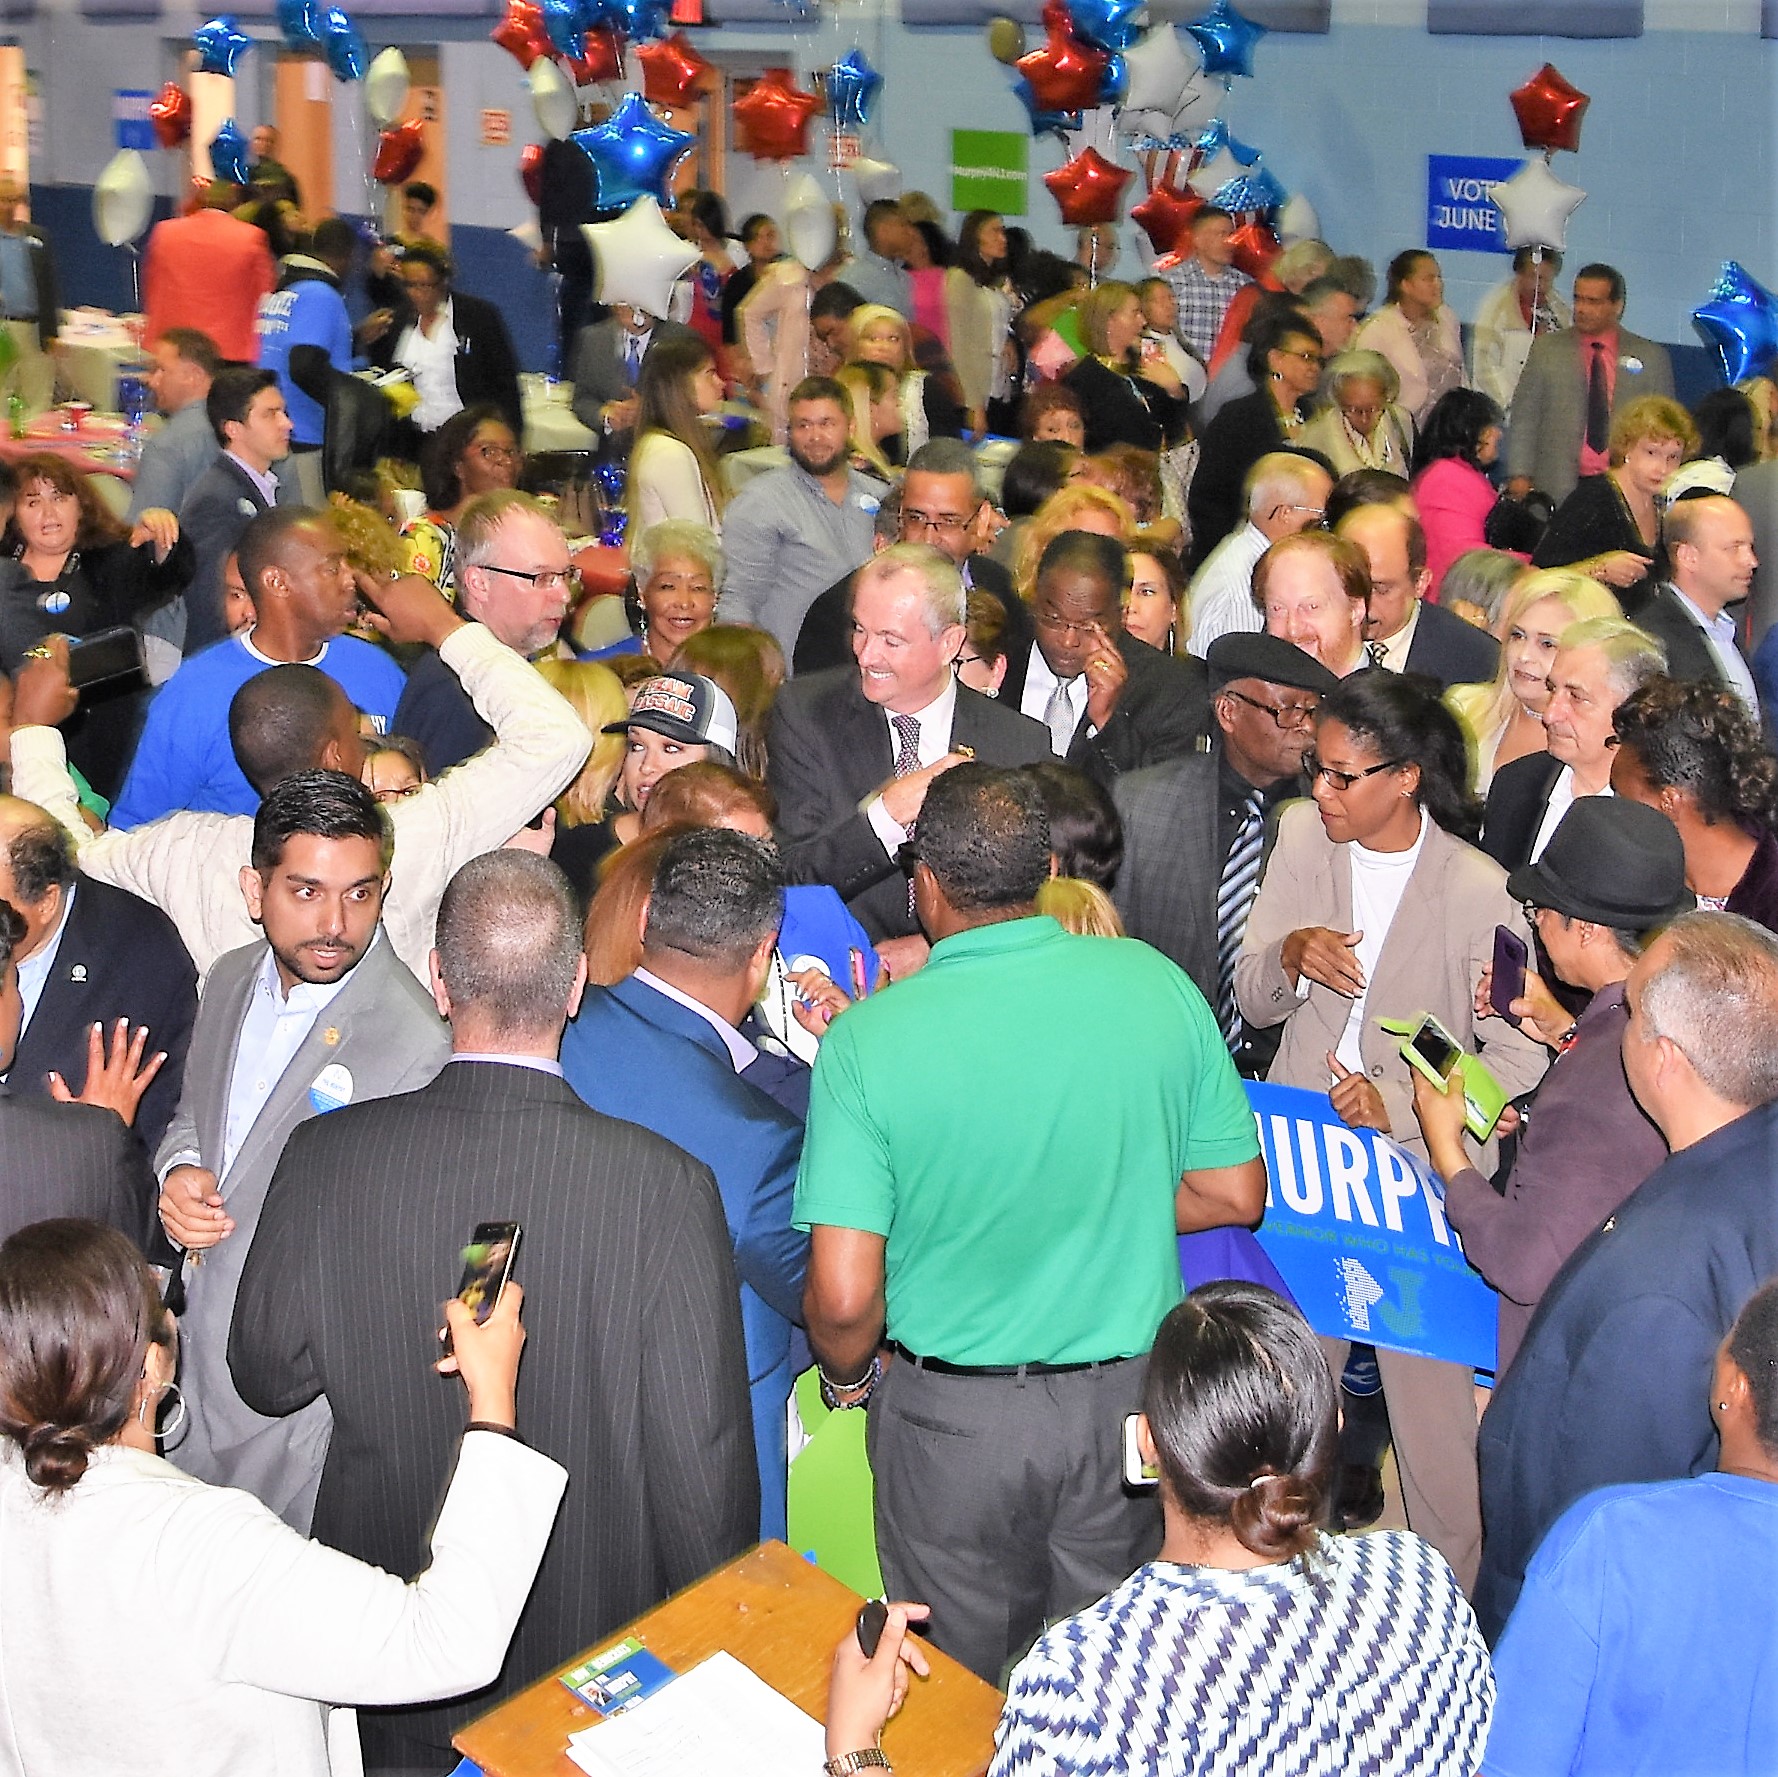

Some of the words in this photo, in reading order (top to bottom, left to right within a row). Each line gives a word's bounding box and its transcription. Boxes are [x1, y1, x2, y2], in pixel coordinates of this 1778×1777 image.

[1439, 206, 1496, 232] JUNE
[1262, 1221, 1338, 1243] VERNOR
[1342, 1233, 1390, 1255] WHO
[1393, 1243, 1430, 1264] HAS
